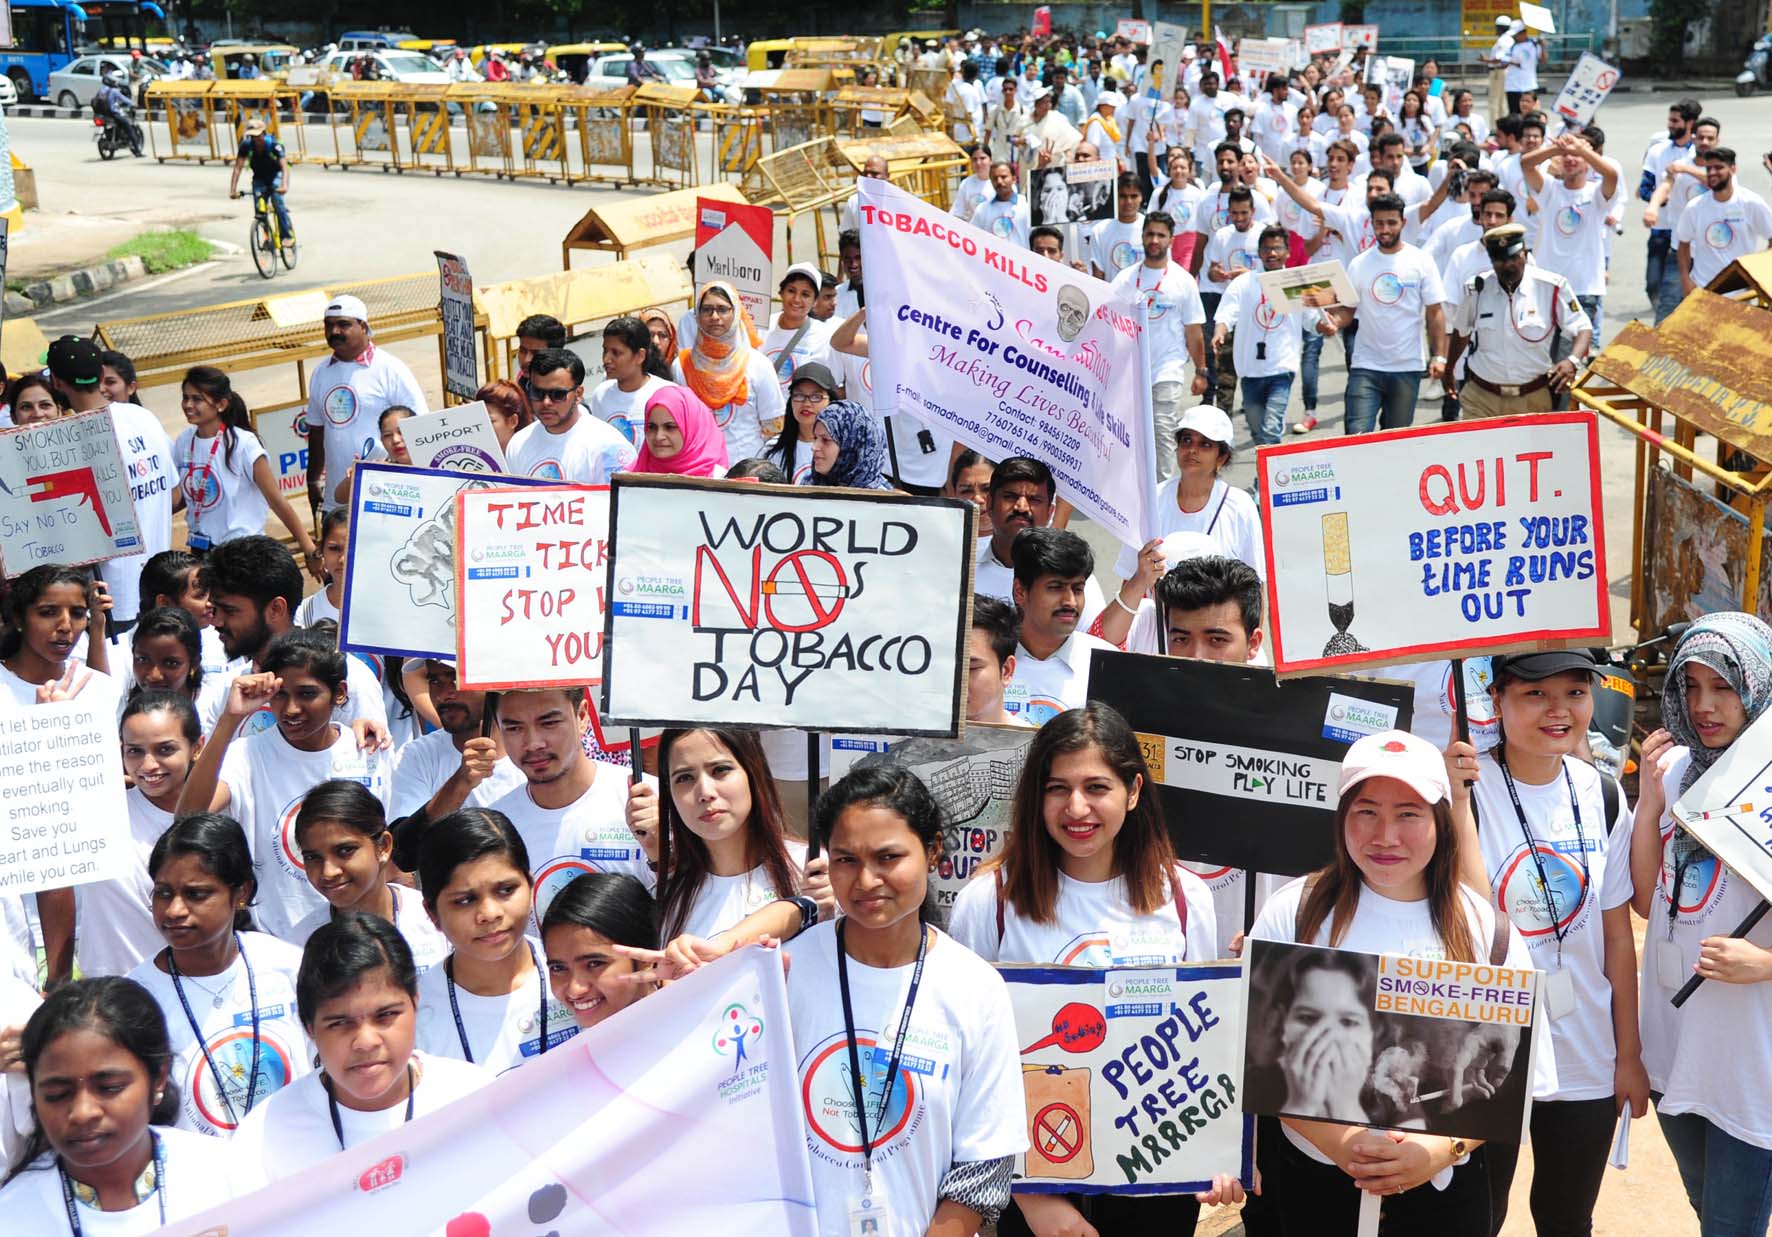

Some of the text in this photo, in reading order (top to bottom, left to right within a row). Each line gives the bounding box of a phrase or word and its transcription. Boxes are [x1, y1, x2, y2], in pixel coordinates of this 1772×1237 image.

[706, 254, 761, 282] Marlboro
[984, 247, 1048, 293] KILLS
[898, 304, 1130, 448] Centre For Counselling Skills
[928, 345, 1011, 398] Making
[1014, 386, 1064, 420] Lives
[440, 418, 448, 426] I
[999, 400, 1036, 428] Contact:
[15, 416, 111, 451] SMOKING THRILLS
[128, 436, 146, 453] SAY
[416, 424, 482, 446] SUPPORT
[51, 448, 78, 468] BUT
[148, 455, 160, 472] TO
[1292, 470, 1334, 482] MAARGA
[103, 490, 121, 504] YOU
[488, 497, 584, 531] TIME
[698, 511, 918, 555] WORLD
[1408, 514, 1588, 561] BEFORE YOUR
[486, 550, 526, 558] MAARGA
[1505, 550, 1594, 587] RUNS
[636, 584, 684, 594] MAARGA
[692, 543, 848, 632] NO
[500, 588, 575, 626] STOP
[1461, 589, 1532, 622] OUT
[693, 627, 931, 675] TOBACCO
[692, 662, 814, 706] DAY
[10, 716, 28, 732] let
[32, 712, 71, 732] being
[74, 712, 92, 725] on
[1346, 712, 1389, 728] MAARGA
[46, 732, 102, 752] ultimate
[28, 752, 104, 773] the reason
[1174, 746, 1312, 778] STOP SMOKING
[2, 772, 105, 800] eventually quit
[1286, 780, 1328, 802] LIFE
[11, 821, 78, 842] Save you
[32, 842, 59, 859] and
[64, 836, 107, 856] Lungs
[0, 868, 36, 886] while
[40, 864, 66, 882] you
[1380, 956, 1533, 988] I SUPPORT
[1124, 984, 1172, 994] MAARGA
[1380, 977, 1530, 1006] SMOKE-FREE
[1376, 994, 1530, 1026] BENGALURU
[1101, 992, 1220, 1100] PEOPLE
[718, 1062, 768, 1090] PEOPLE TREE
[720, 1072, 766, 1099] HOSPITALS
[1115, 1057, 1208, 1137] TREE
[822, 1107, 838, 1117] Not
